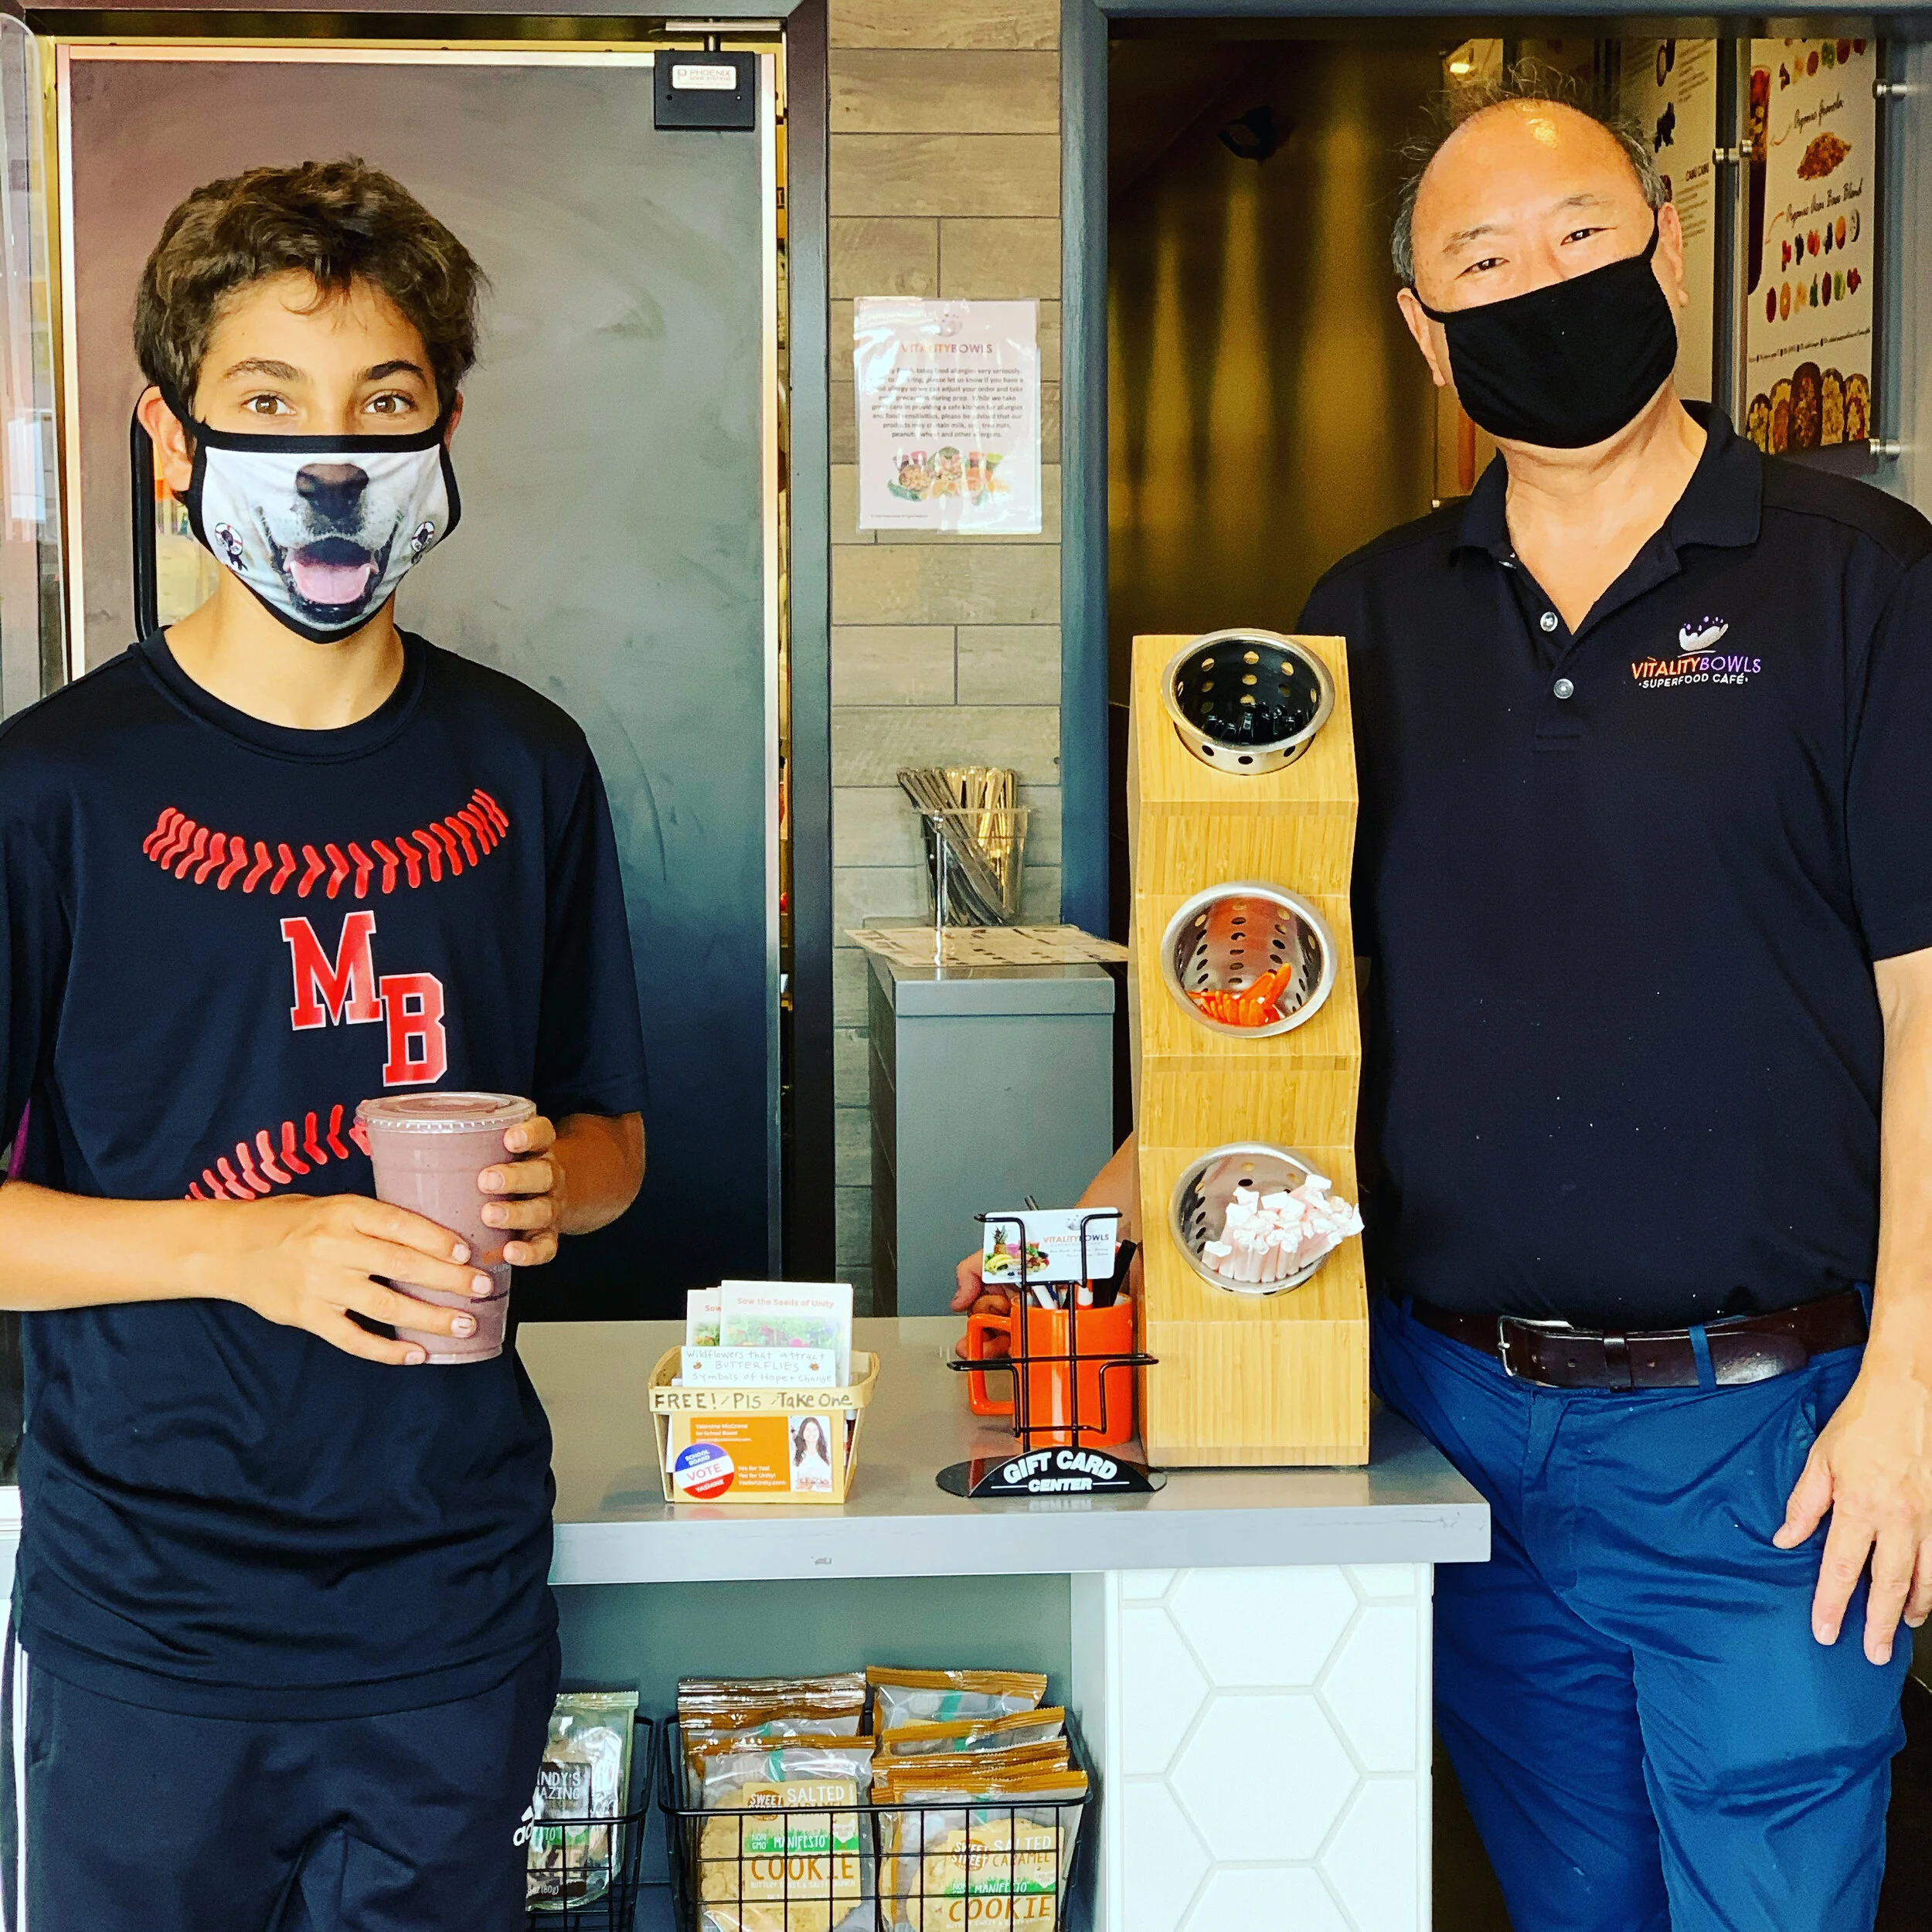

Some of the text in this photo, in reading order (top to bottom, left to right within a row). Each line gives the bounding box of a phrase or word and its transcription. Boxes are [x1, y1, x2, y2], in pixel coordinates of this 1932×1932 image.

[1631, 655, 1761, 680] VITALITYBOWLS
[1641, 673, 1709, 689] SUPERFOOD
[1043, 1233, 1110, 1243] VITALITYOWLS
[757, 1298, 771, 1306] the
[774, 1298, 799, 1307] Seeds
[811, 1300, 834, 1308] Unity
[685, 1349, 825, 1360] Wildflowers that attract
[715, 1361, 800, 1371] BUTTERFLIES
[692, 1372, 738, 1383] Symbols
[743, 1373, 757, 1382] of
[777, 1392, 815, 1409] Take
[818, 1393, 853, 1408] One
[685, 1450, 710, 1461] SCHOOL
[688, 1455, 710, 1466] BOARD
[686, 1463, 723, 1481] VOTE
[1003, 1450, 1117, 1484] GIFT CARD
[695, 1478, 725, 1492] YASMINE
[1028, 1478, 1093, 1492] CENTER
[750, 1793, 784, 1806] SWEET
[787, 1786, 845, 1803] SALTED
[752, 1842, 767, 1850] GMO
[774, 1835, 826, 1849] MANIFESTO
[993, 1835, 1052, 1851] SALTED
[975, 1882, 1028, 1894] MANIFETO
[949, 1896, 1053, 1922] COOKIE
